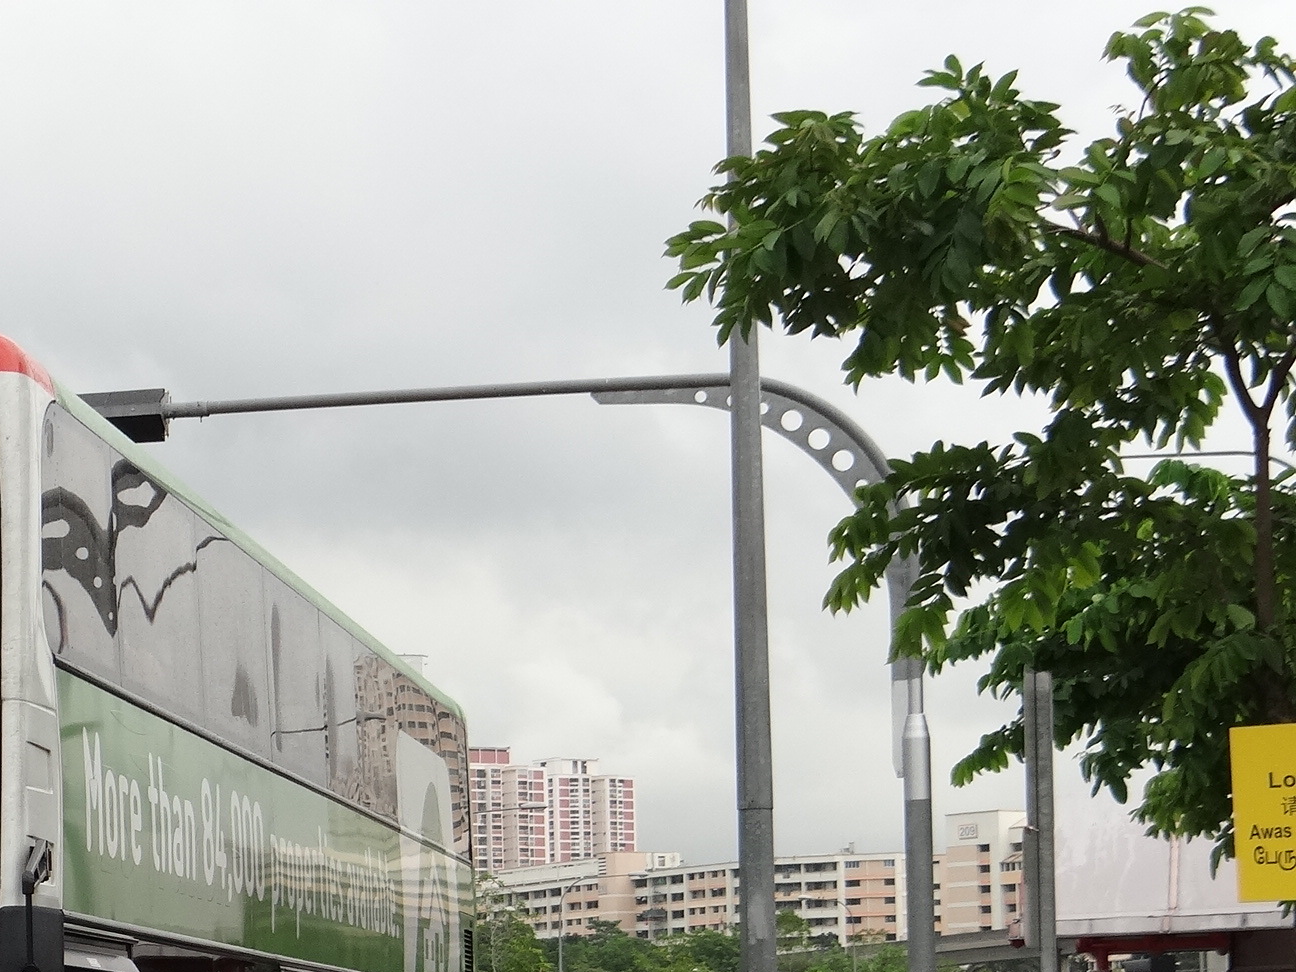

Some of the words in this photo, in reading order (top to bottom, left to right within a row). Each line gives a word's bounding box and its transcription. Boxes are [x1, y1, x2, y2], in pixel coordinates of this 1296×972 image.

[82, 726, 142, 866] More
[148, 752, 196, 881] than
[201, 777, 265, 902] 84,000
[270, 825, 344, 940] properties
[959, 826, 975, 837] 209
[1249, 824, 1292, 840] Awas
